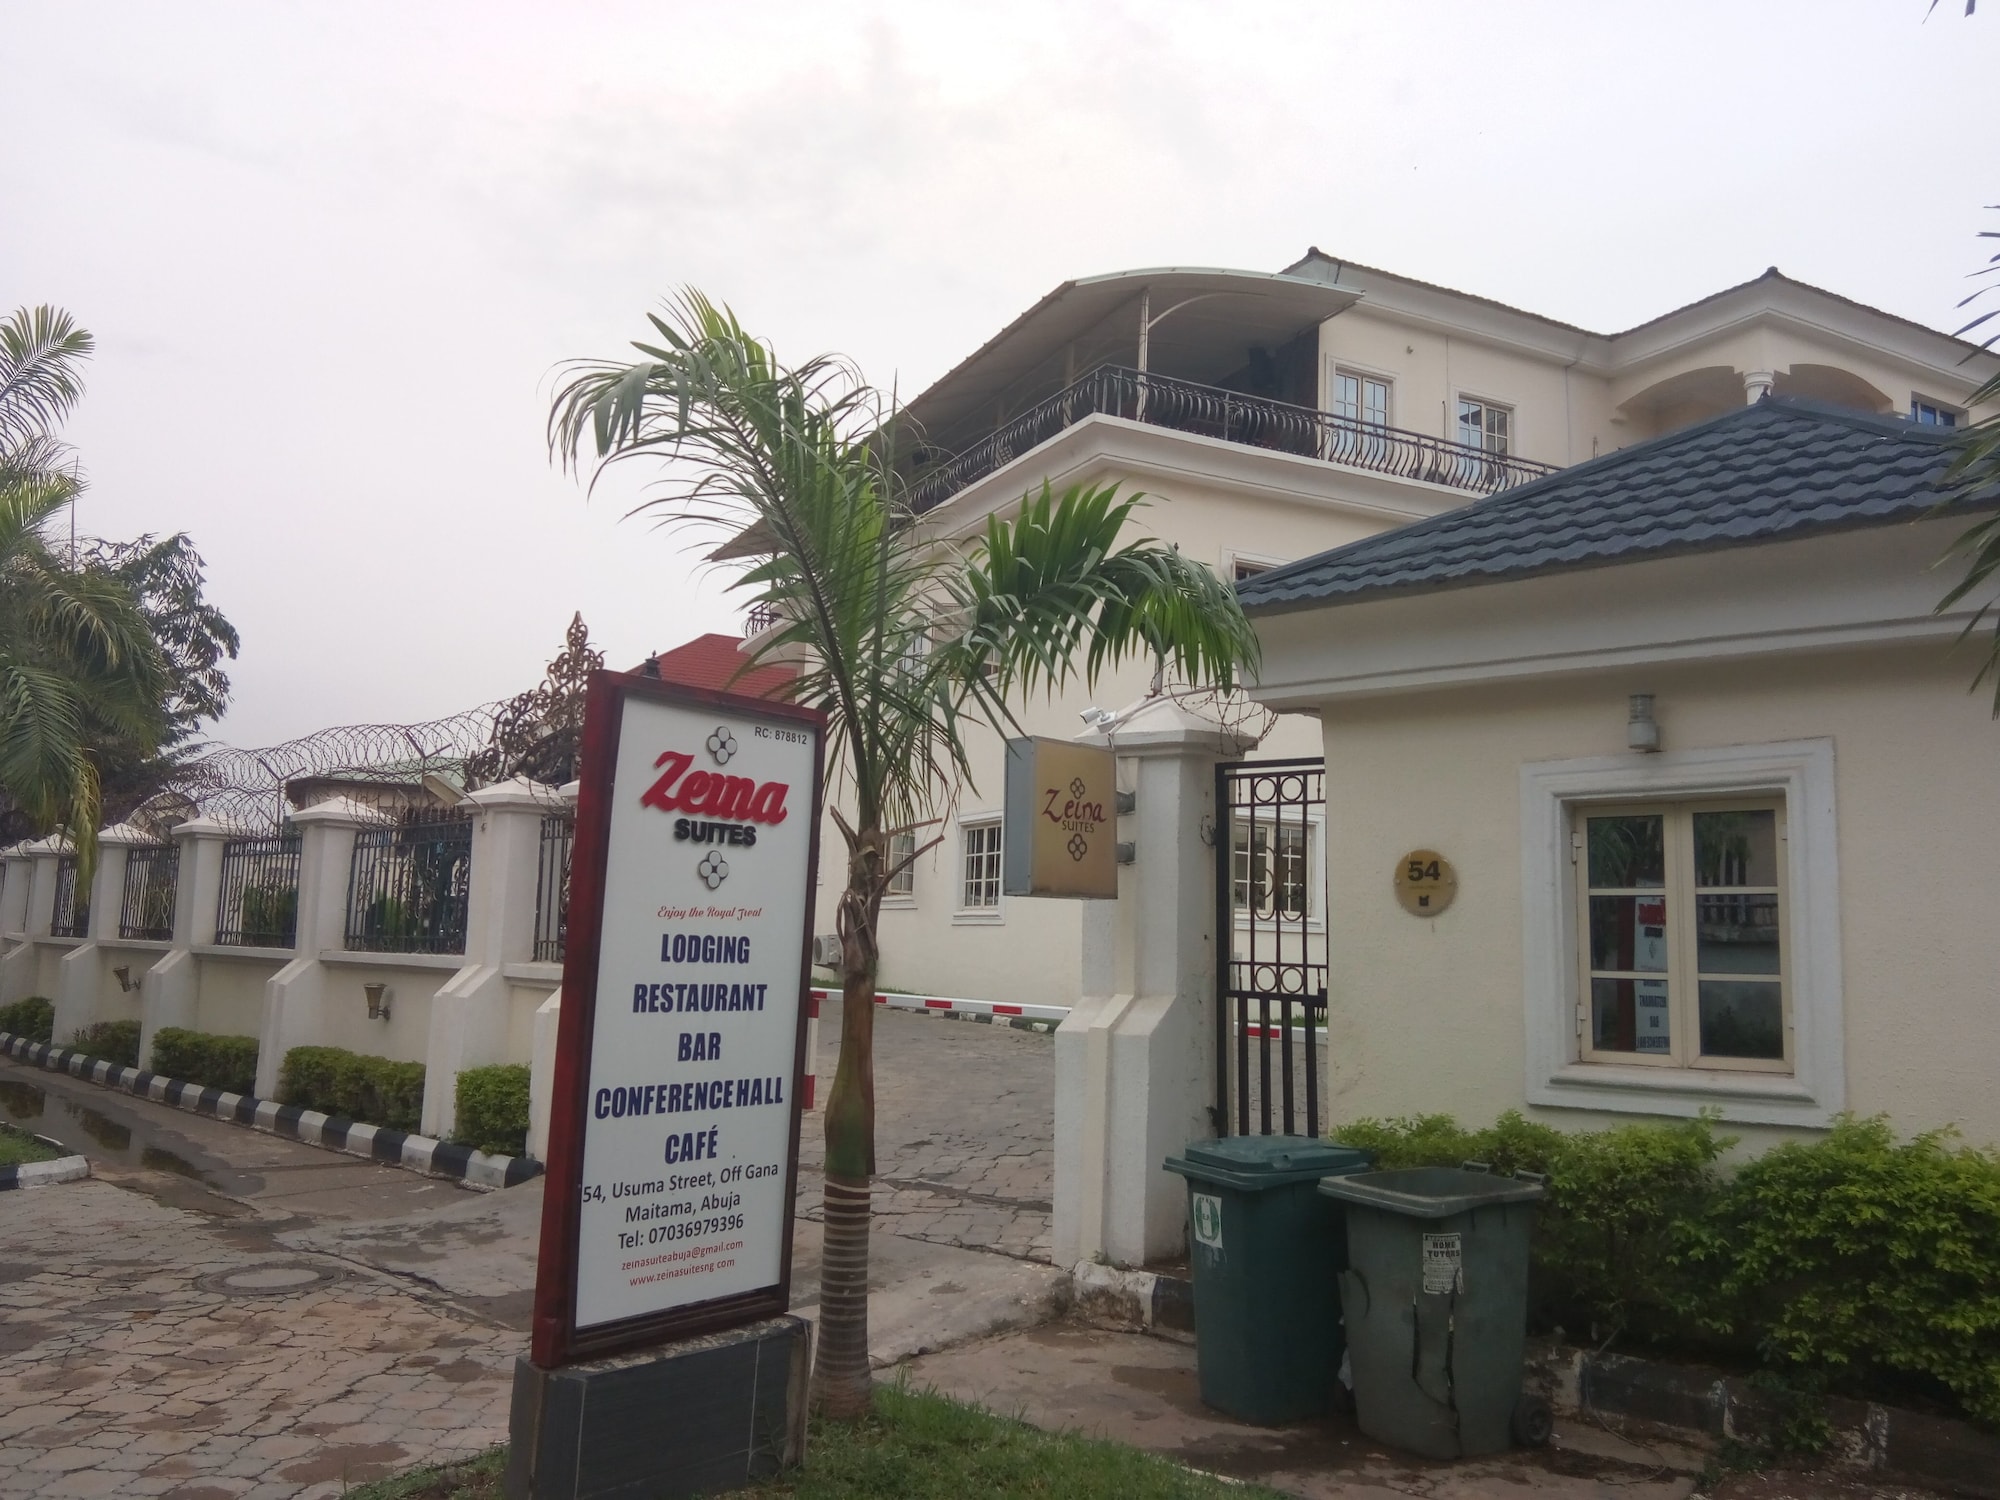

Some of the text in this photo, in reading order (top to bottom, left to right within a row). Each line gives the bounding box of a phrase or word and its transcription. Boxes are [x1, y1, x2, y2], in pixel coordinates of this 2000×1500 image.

[755, 727, 807, 745] RC: 878812
[1042, 788, 1106, 823] Zeina
[675, 818, 756, 846] SUITES
[1062, 820, 1095, 833] SUITES
[1408, 861, 1440, 881] 54
[657, 905, 686, 920] Enjoy
[689, 906, 704, 918] the
[707, 905, 736, 919] Royal
[661, 934, 750, 963] LODGING
[632, 983, 767, 1013] RESTAURANT
[677, 1032, 721, 1062] BAR
[595, 1076, 783, 1119] CONFERENCE HALL
[664, 1125, 718, 1164] CAFÉ
[582, 1163, 778, 1204] 54, Usuma Street, Off Gana
[625, 1191, 741, 1223] Maitama, Abuja
[618, 1213, 744, 1250] Tel: 07036979396
[629, 1258, 735, 1287] www.zeinasuitesngcom
